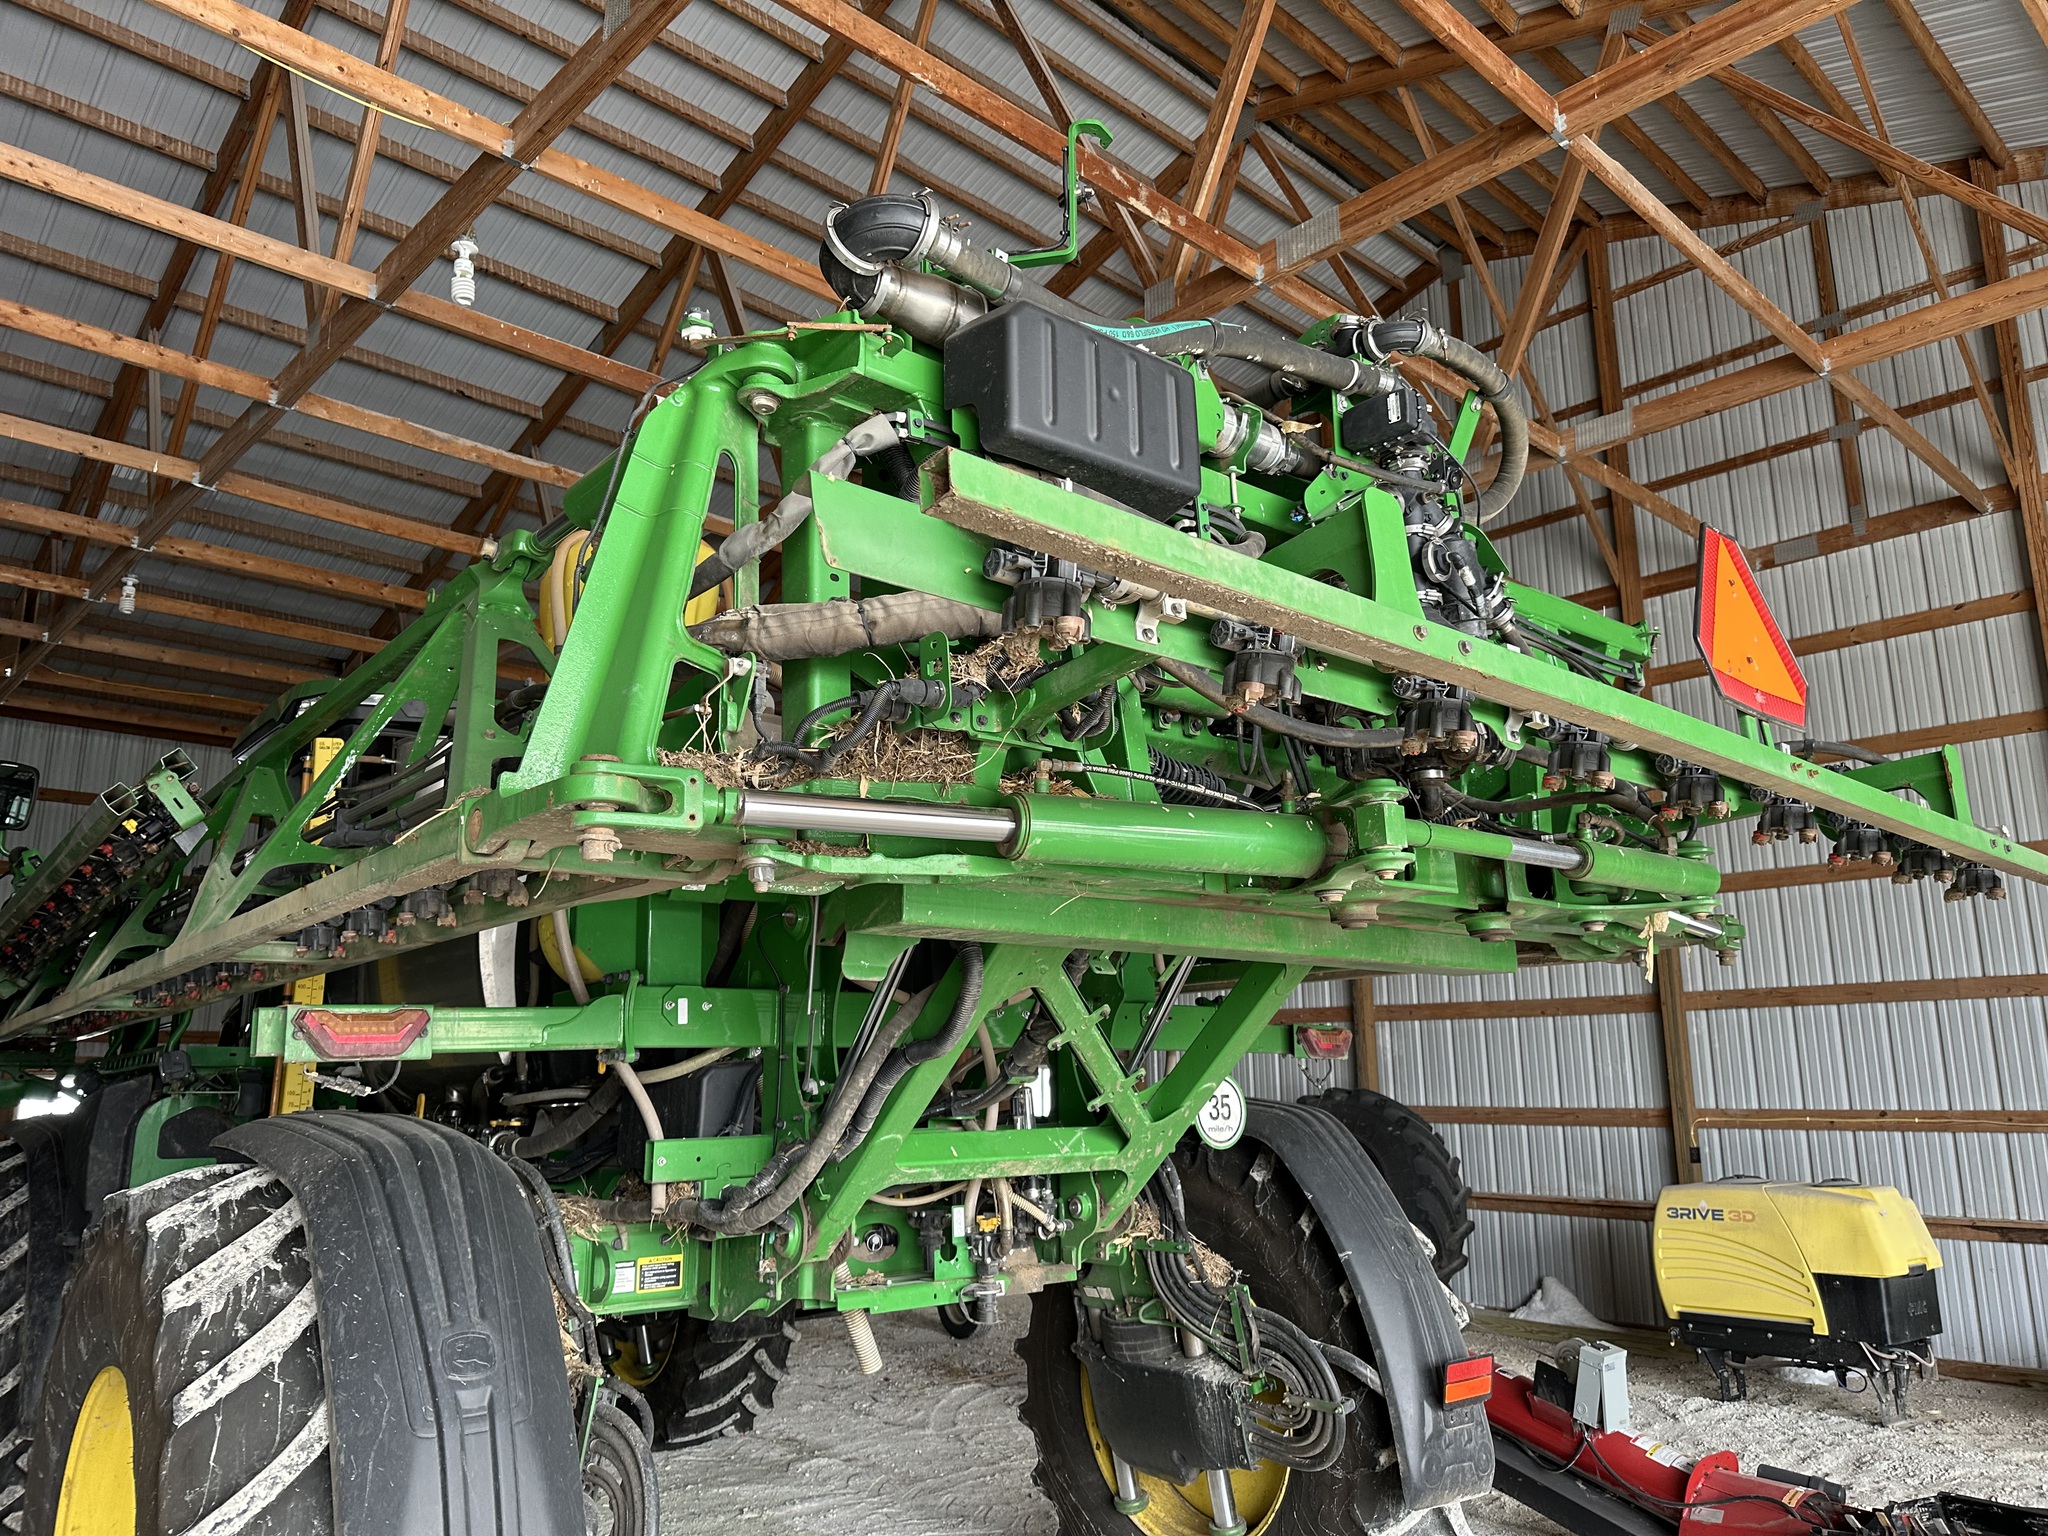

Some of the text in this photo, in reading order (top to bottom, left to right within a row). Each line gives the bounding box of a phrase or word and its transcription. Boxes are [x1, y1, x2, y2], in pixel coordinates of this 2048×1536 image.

[1108, 330, 1119, 338] 150
[1134, 327, 1161, 338] VERSIFLO
[1208, 1094, 1231, 1121] 35
[1208, 1124, 1234, 1133] mile/h
[1666, 1207, 1756, 1223] 3RIVE 3D
